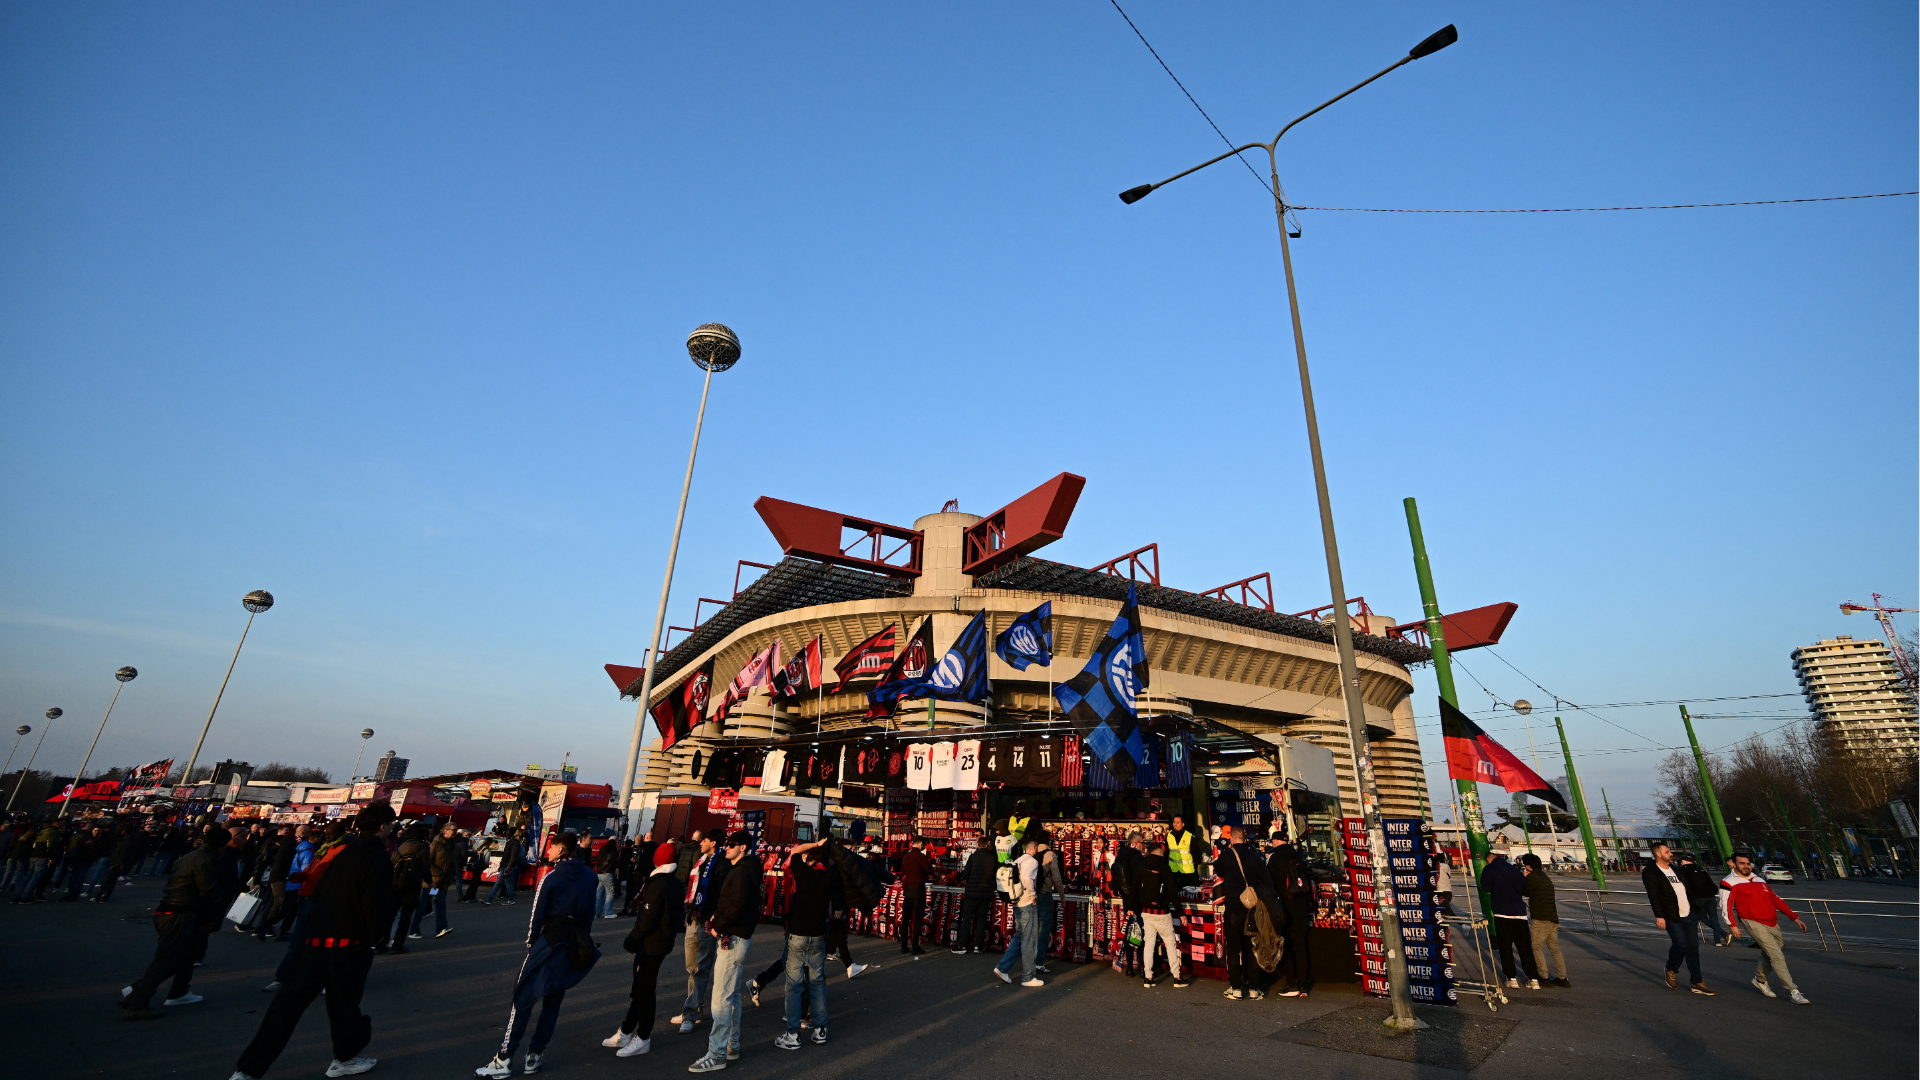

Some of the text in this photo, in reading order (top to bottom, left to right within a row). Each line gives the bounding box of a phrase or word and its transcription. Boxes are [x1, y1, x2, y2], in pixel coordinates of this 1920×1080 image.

[1140, 748, 1150, 765] 2
[1170, 741, 1183, 763] 10
[914, 756, 924, 770] 10
[961, 754, 975, 771] 23
[987, 754, 997, 772] 4
[1013, 751, 1024, 768] 14
[1039, 751, 1051, 768] 11
[1238, 790, 1257, 799] INTER
[1236, 800, 1261, 813] INTER
[1242, 813, 1261, 825] INTER
[964, 821, 981, 829] MILAN
[1349, 821, 1366, 831] MIL
[1387, 822, 1410, 832] INTER
[890, 833, 907, 841] MILAN
[1389, 839, 1412, 848] INTER
[1353, 854, 1370, 864] MIL
[1393, 857, 1416, 867] INTER
[1356, 873, 1373, 883] MIL
[1395, 875, 1418, 885] INTER
[882, 887, 890, 914] MILAN
[889, 889, 898, 917] MILAN
[1397, 893, 1422, 903] INTER
[897, 888, 906, 922] MILAN
[953, 892, 962, 921] MILAN
[1359, 907, 1379, 917] MILA
[1399, 909, 1424, 919] INTER
[1362, 924, 1382, 934] MILA
[1402, 927, 1427, 937] INTER
[1364, 942, 1385, 953] MILA
[1405, 945, 1430, 957] INTER
[1366, 960, 1387, 971] MILA
[1408, 965, 1432, 976] INTER
[1368, 979, 1390, 991] MILA
[1410, 985, 1435, 997] INTER
